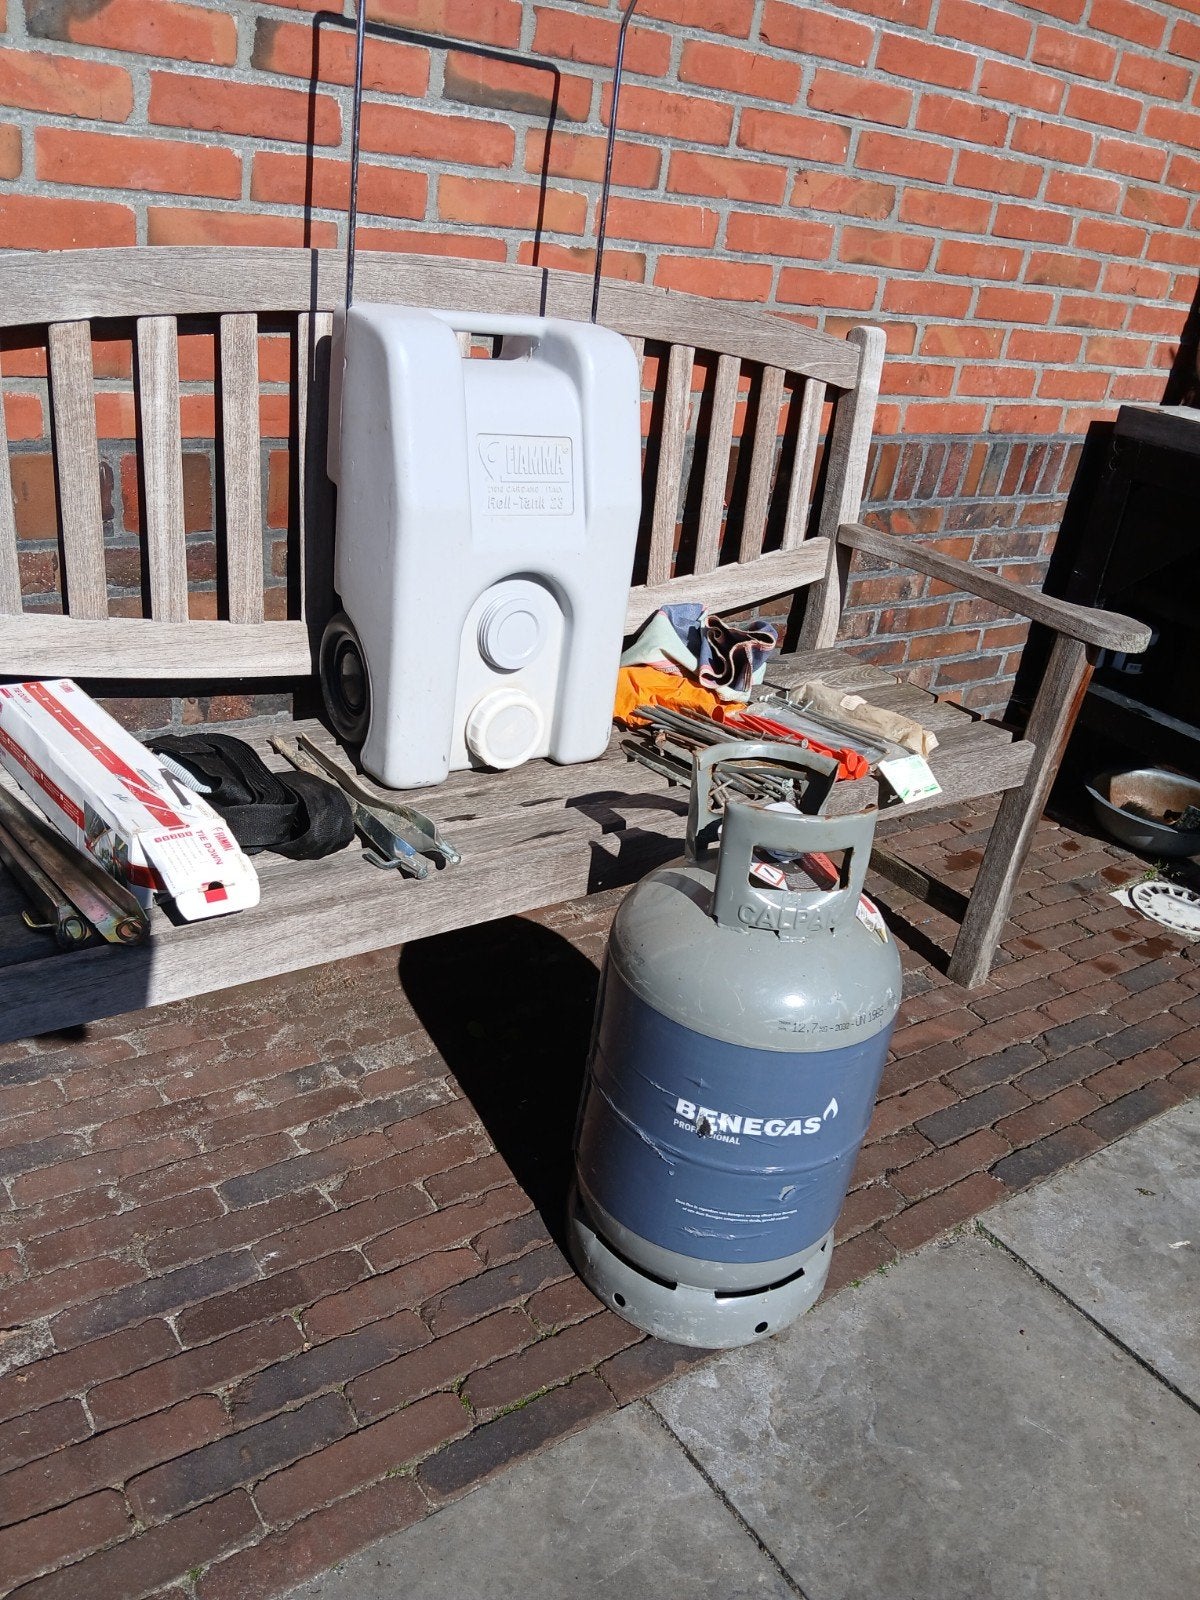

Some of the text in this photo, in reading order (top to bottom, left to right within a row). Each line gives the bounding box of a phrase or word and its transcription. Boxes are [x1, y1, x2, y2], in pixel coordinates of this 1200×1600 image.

[504, 444, 564, 475] FIAMMA
[203, 841, 224, 865] DOWN
[675, 1097, 823, 1137] BENEGAS
[673, 1118, 741, 1146] PROFIONAL
